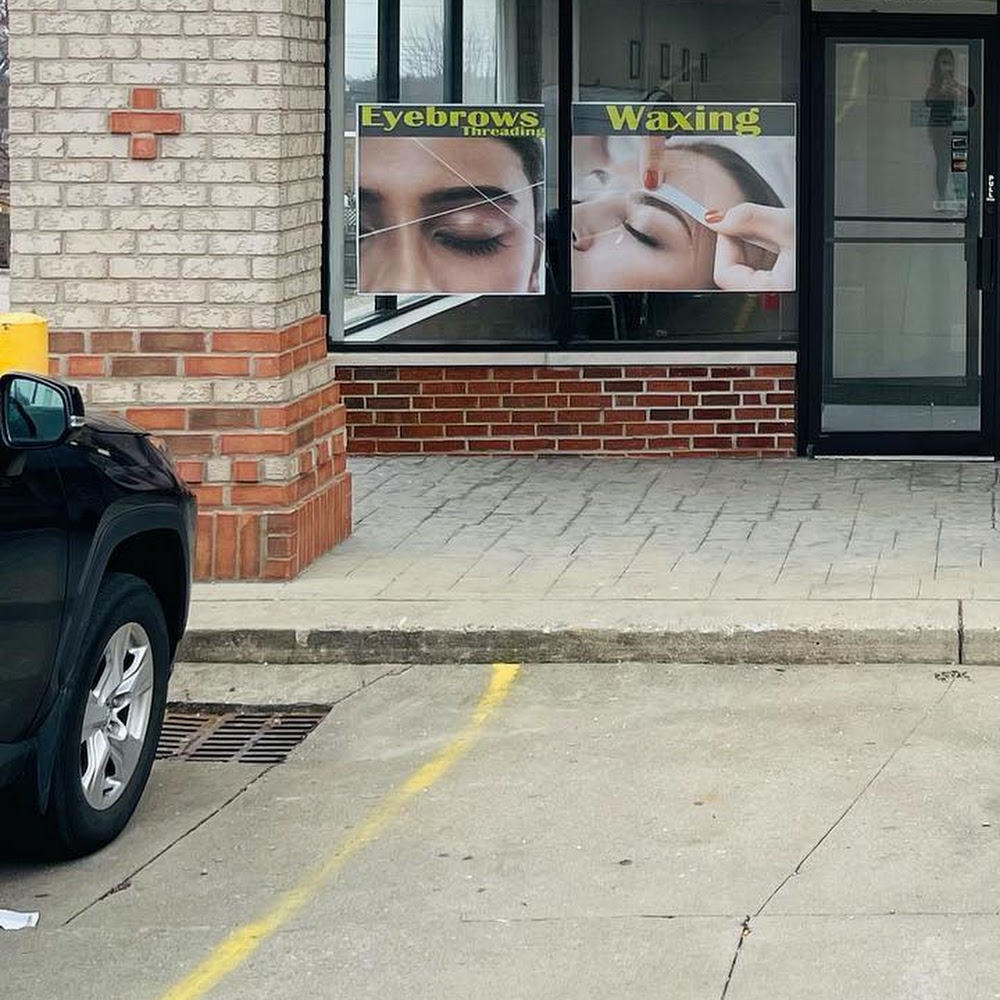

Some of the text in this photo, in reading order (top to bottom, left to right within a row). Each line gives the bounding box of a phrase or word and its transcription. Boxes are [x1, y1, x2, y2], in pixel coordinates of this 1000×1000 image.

[361, 105, 540, 132] Eyebrows
[461, 126, 547, 138] Threading
[605, 105, 762, 137] Waxing
